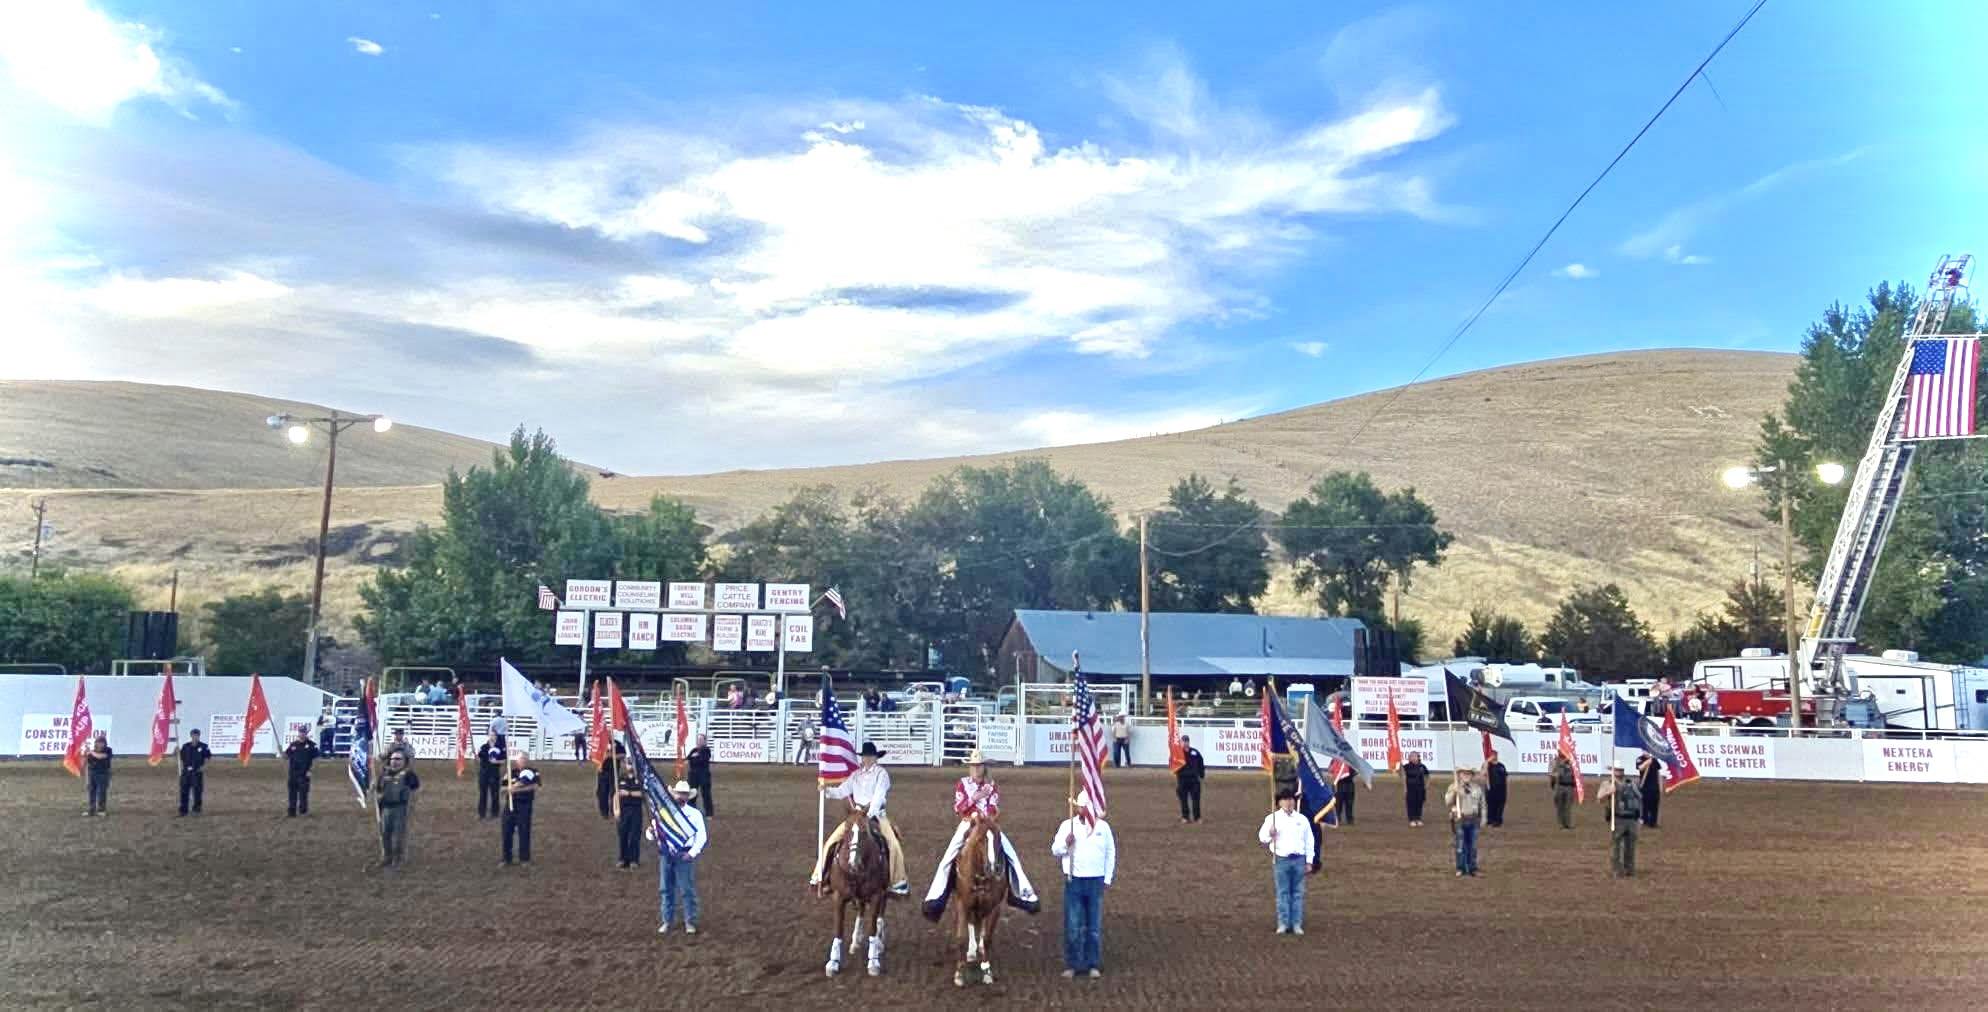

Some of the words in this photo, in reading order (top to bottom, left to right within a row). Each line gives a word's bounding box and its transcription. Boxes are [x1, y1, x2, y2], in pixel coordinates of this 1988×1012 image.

[789, 625, 808, 633] COIL
[632, 632, 654, 640] RANCH
[790, 635, 807, 643] FAB
[25, 729, 107, 739] CONSTRON
[1219, 729, 1264, 739] SWANSON
[720, 741, 745, 749] DEVIN
[1215, 742, 1265, 751] INSURANC
[1401, 738, 1433, 749] COUNTY
[1540, 740, 1558, 750] BAN
[720, 750, 762, 759] COMPANY
[1696, 744, 1715, 754] LES
[1720, 745, 1765, 755] SCHWAB
[1883, 747, 1933, 758] NEXTERA
[1226, 754, 1257, 764] GROUP
[1697, 758, 1721, 768] TIRE
[1726, 759, 1767, 768] CENTER
[1888, 761, 1930, 772] ENERGY
